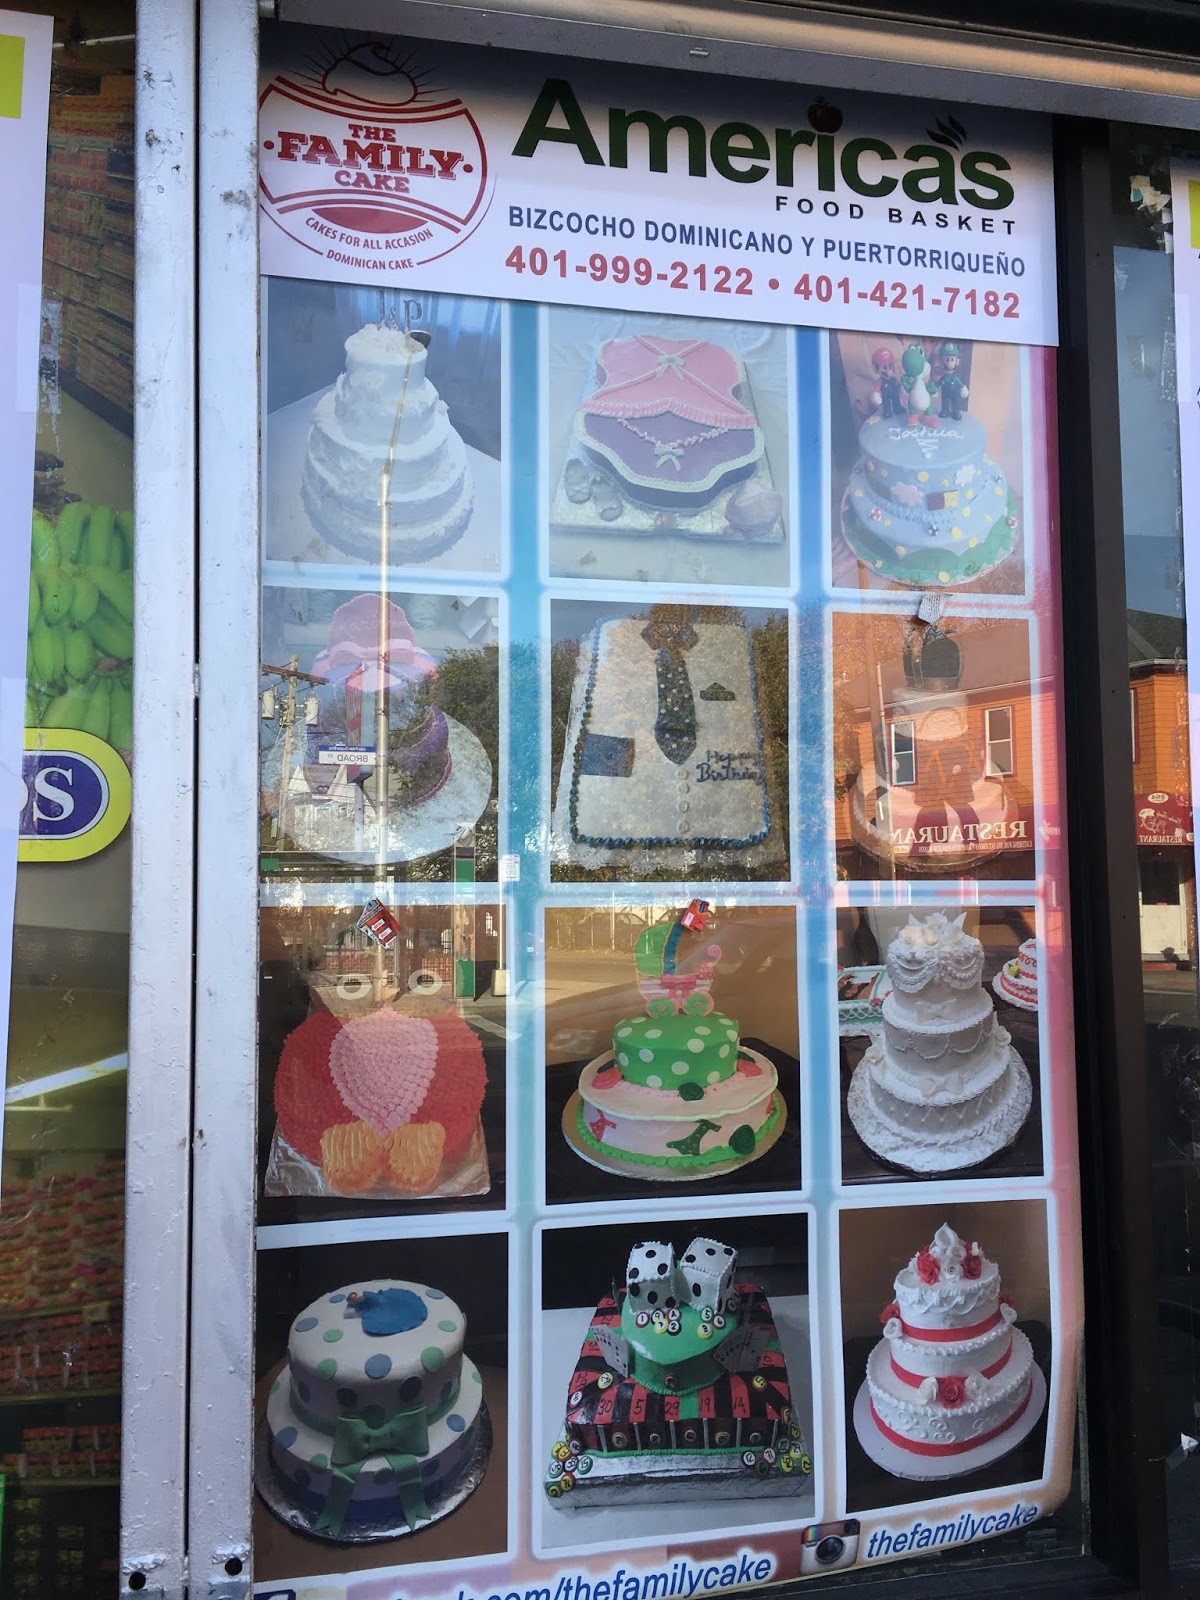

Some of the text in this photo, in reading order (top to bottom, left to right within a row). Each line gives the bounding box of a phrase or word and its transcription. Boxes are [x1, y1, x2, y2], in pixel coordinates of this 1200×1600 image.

[348, 123, 397, 142] THE
[277, 131, 464, 180] FAMILY
[334, 170, 411, 194] CAKE
[305, 217, 434, 251] CAKES FOR ALL ACCASION
[775, 195, 1016, 236] FOOD BASKET
[326, 249, 415, 271] DOMINICAN CAKE
[510, 206, 1026, 278] BIZCOCHO DOMINICANO Y PUERTORRIQUEÑO
[505, 245, 1021, 319] 401-999-2122 401-421-7182
[888, 427, 966, 440] Joshua
[866, 1503, 1038, 1558] thefamilycake
